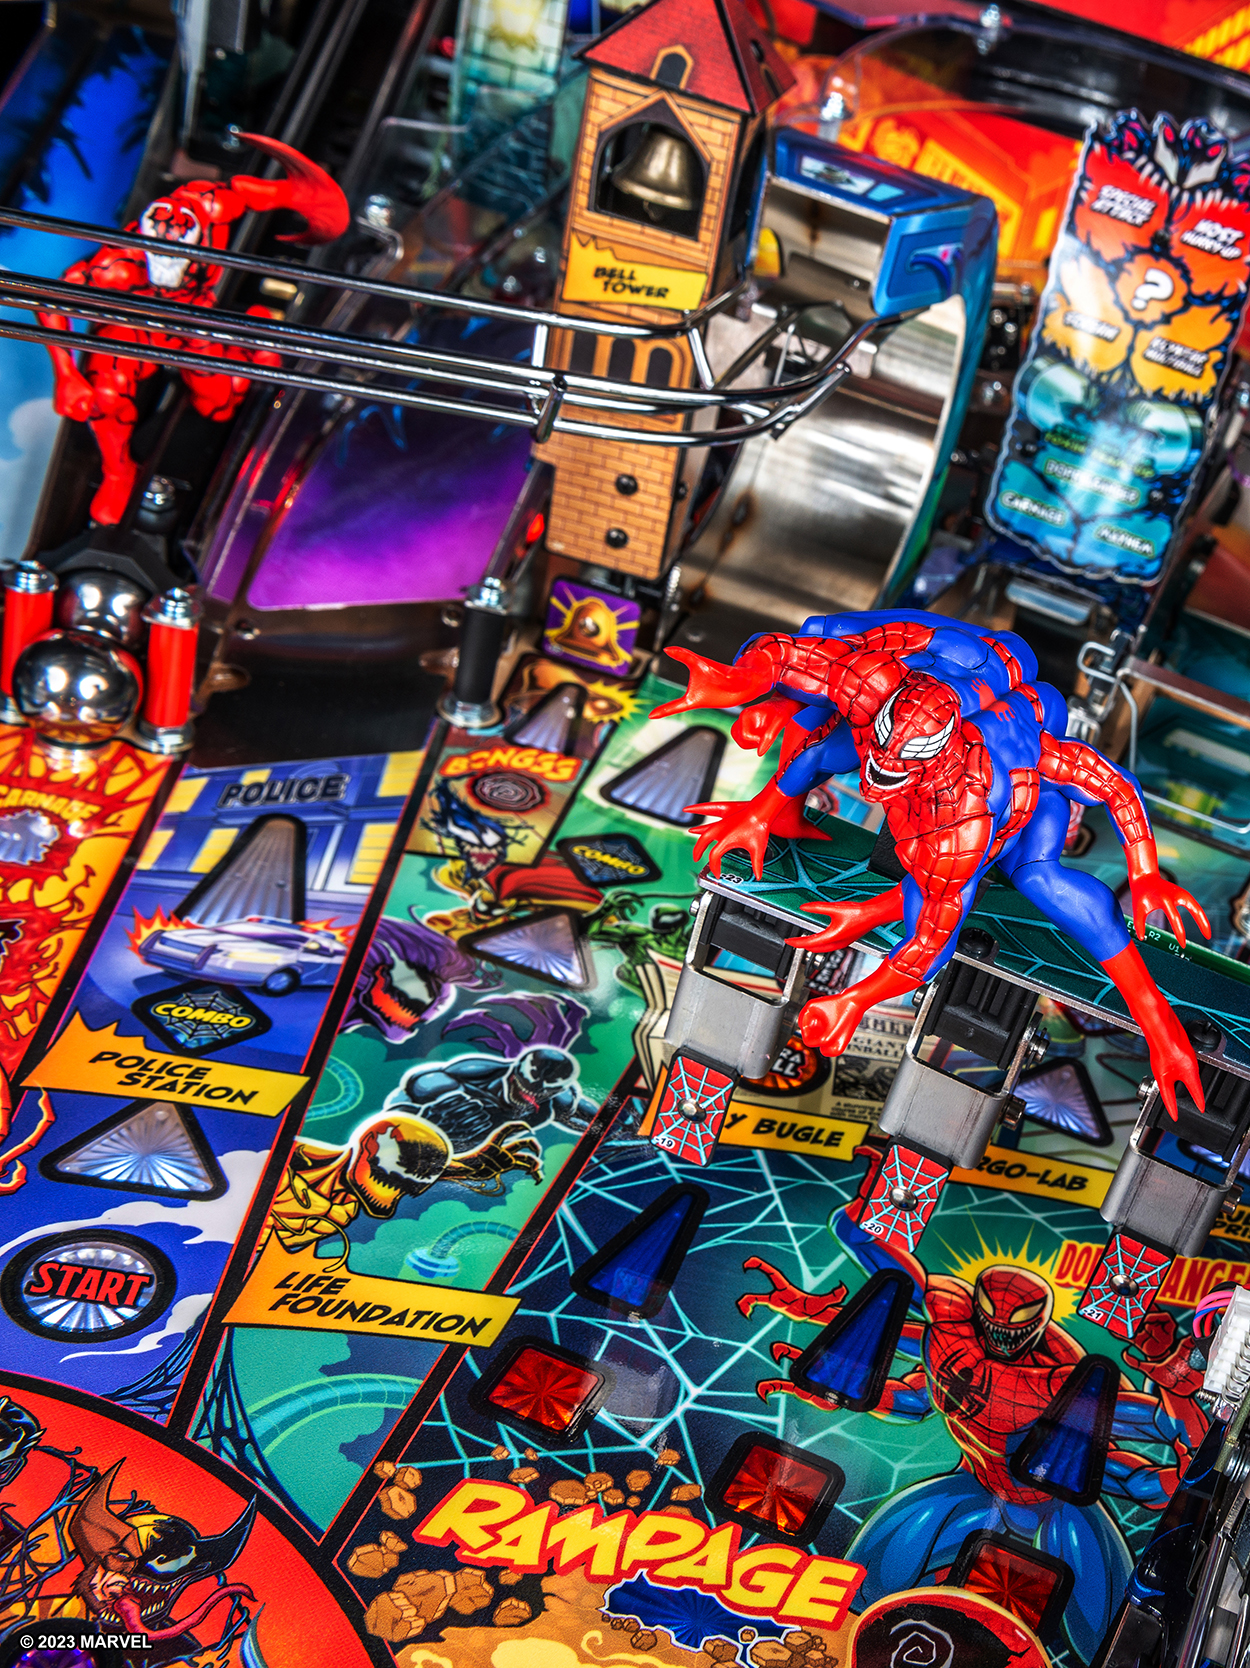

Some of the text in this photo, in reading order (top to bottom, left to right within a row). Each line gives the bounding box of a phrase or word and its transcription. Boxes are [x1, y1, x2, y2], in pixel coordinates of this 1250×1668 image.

[594, 267, 636, 280] BELL
[603, 281, 669, 298] TOWER
[217, 774, 350, 808] POLICE
[572, 845, 647, 876] COMBO
[154, 1003, 252, 1028] COMBO
[88, 1051, 212, 1081] POLICE
[117, 1072, 259, 1105] STATION
[752, 1117, 845, 1148] BUGLE
[976, 1156, 1089, 1191] RGO-LAB
[29, 1261, 150, 1306] START
[274, 1271, 351, 1295] LIFE
[268, 1293, 492, 1338] FOUNDATION
[415, 1480, 865, 1627] RAMPAGE
